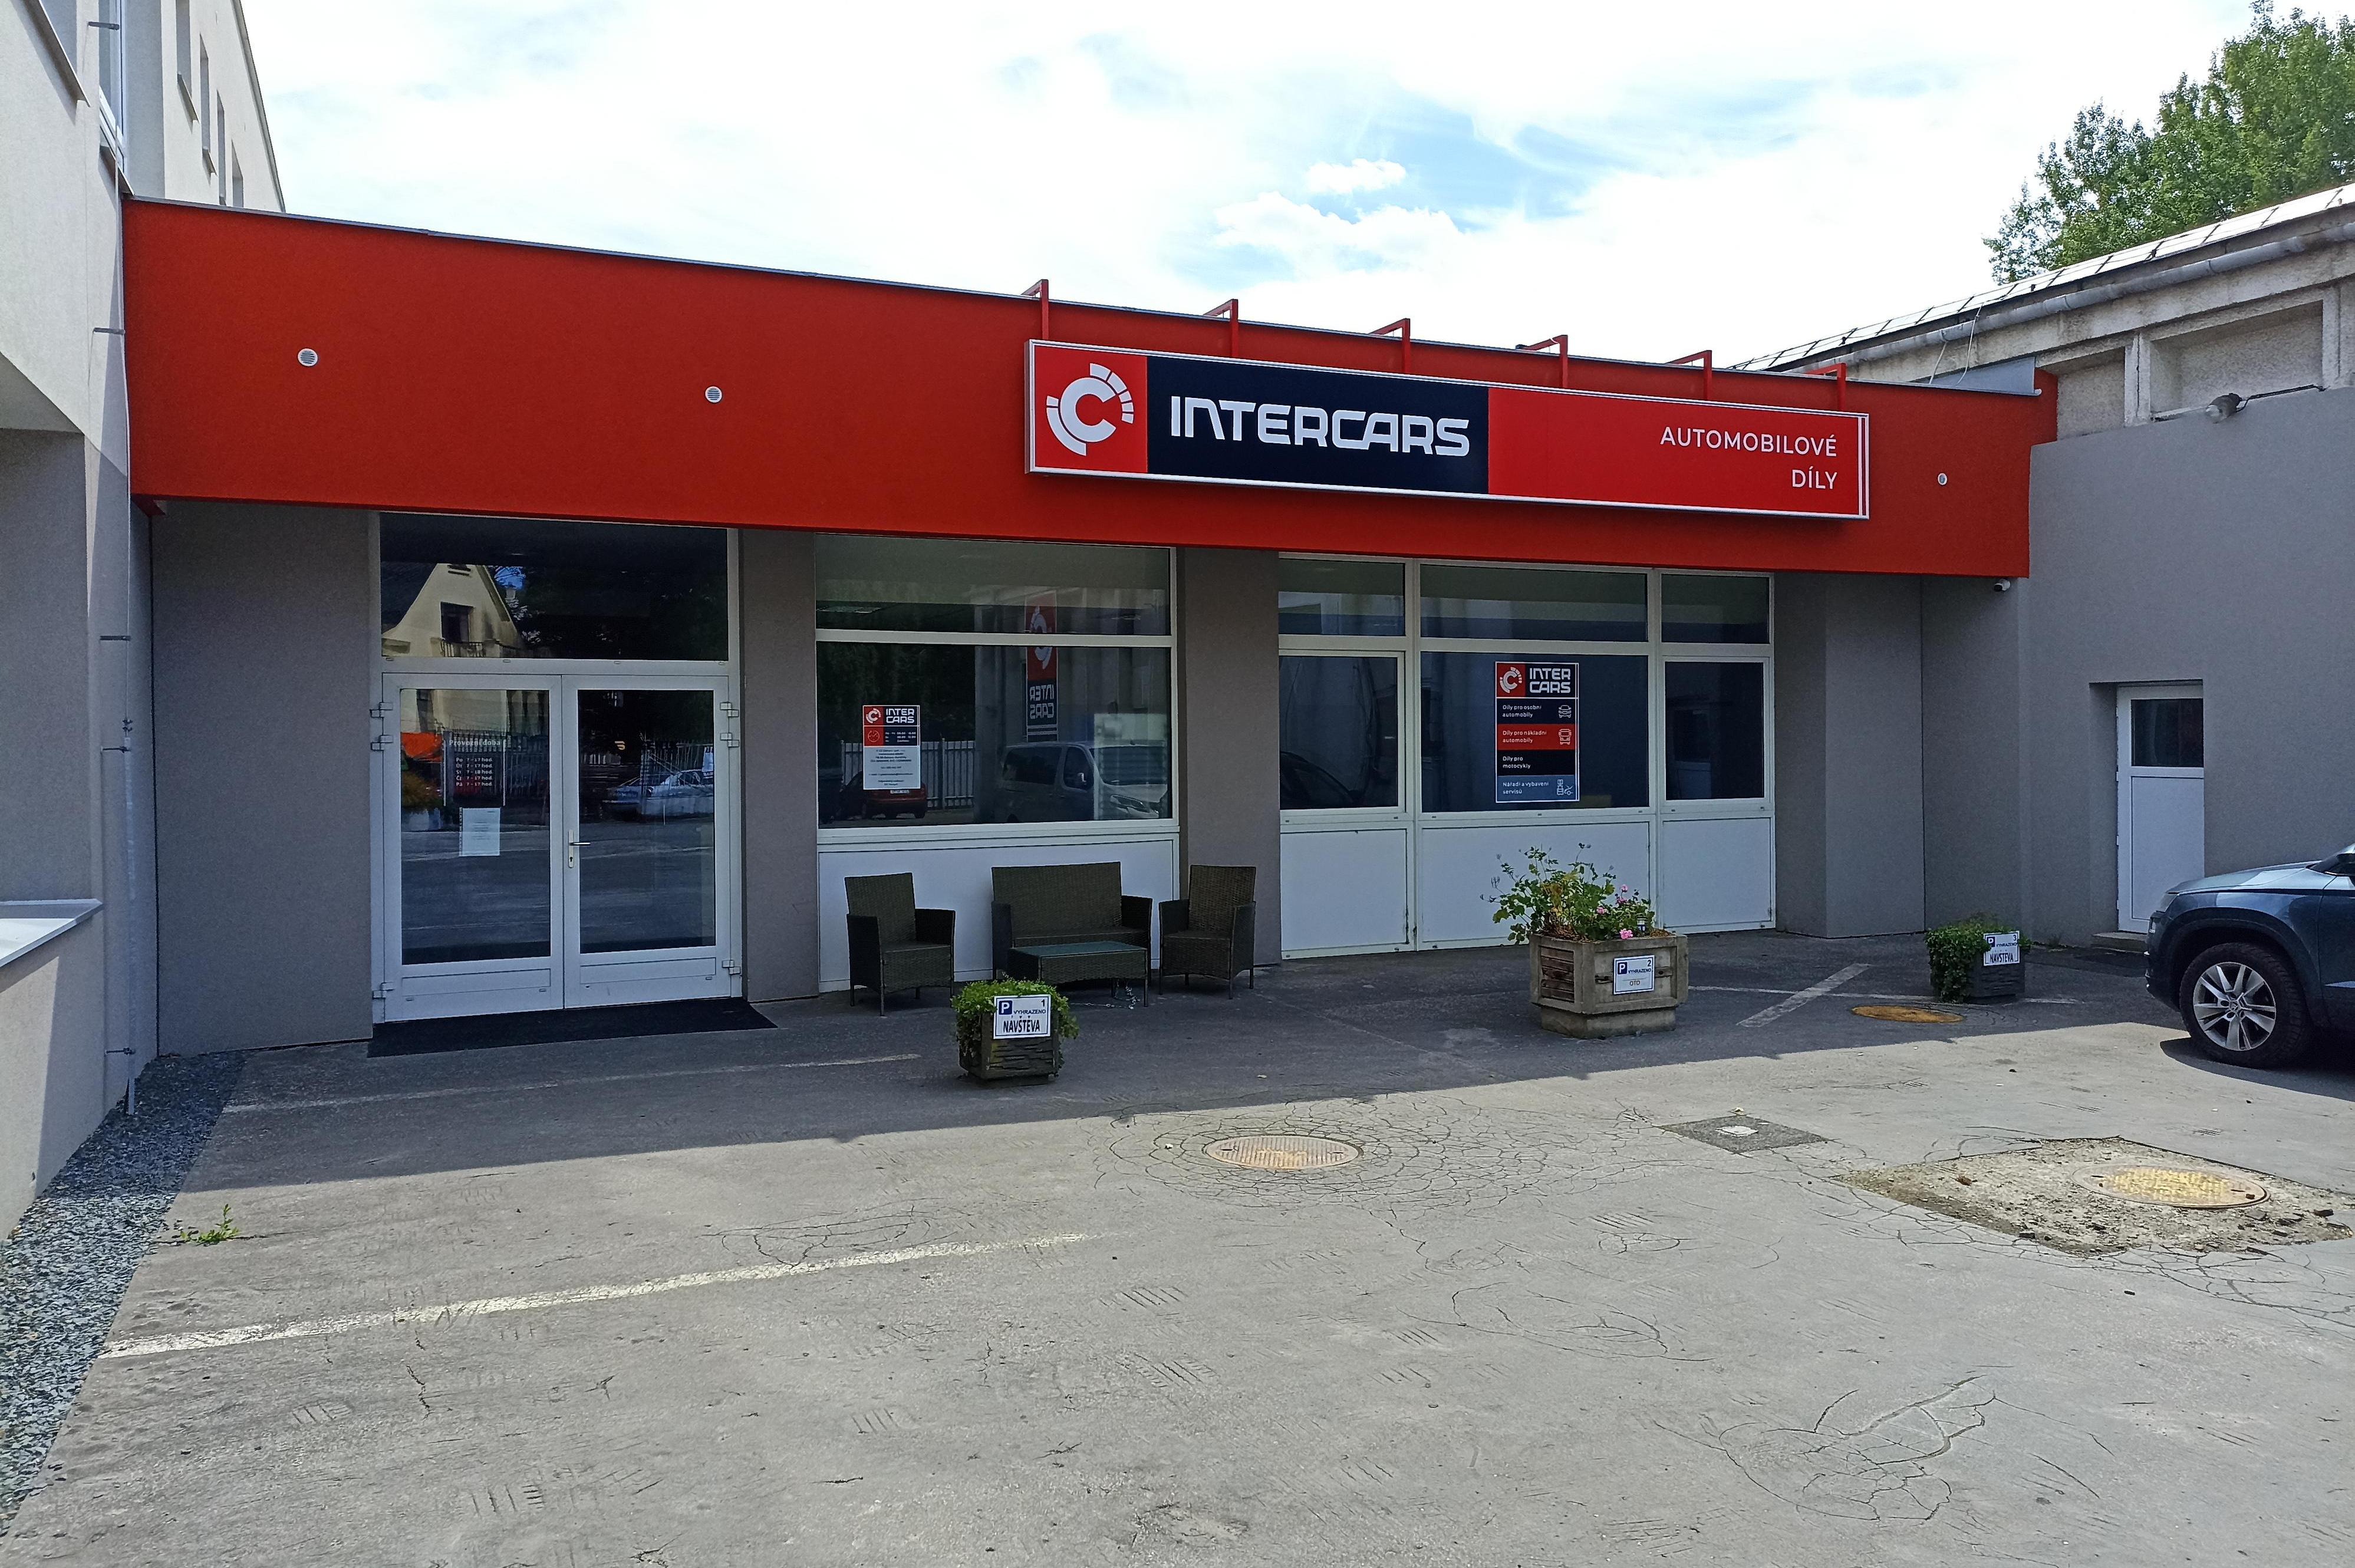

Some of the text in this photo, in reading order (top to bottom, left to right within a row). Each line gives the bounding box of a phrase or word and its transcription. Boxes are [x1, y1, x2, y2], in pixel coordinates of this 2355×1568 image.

[1171, 396, 1470, 457] INTERCARS
[1660, 426, 1837, 457] AUTOMOBILOVÉ
[1791, 466, 1837, 489] DÍLY
[1529, 667, 1571, 680] INTER
[1529, 681, 1571, 693] CARS
